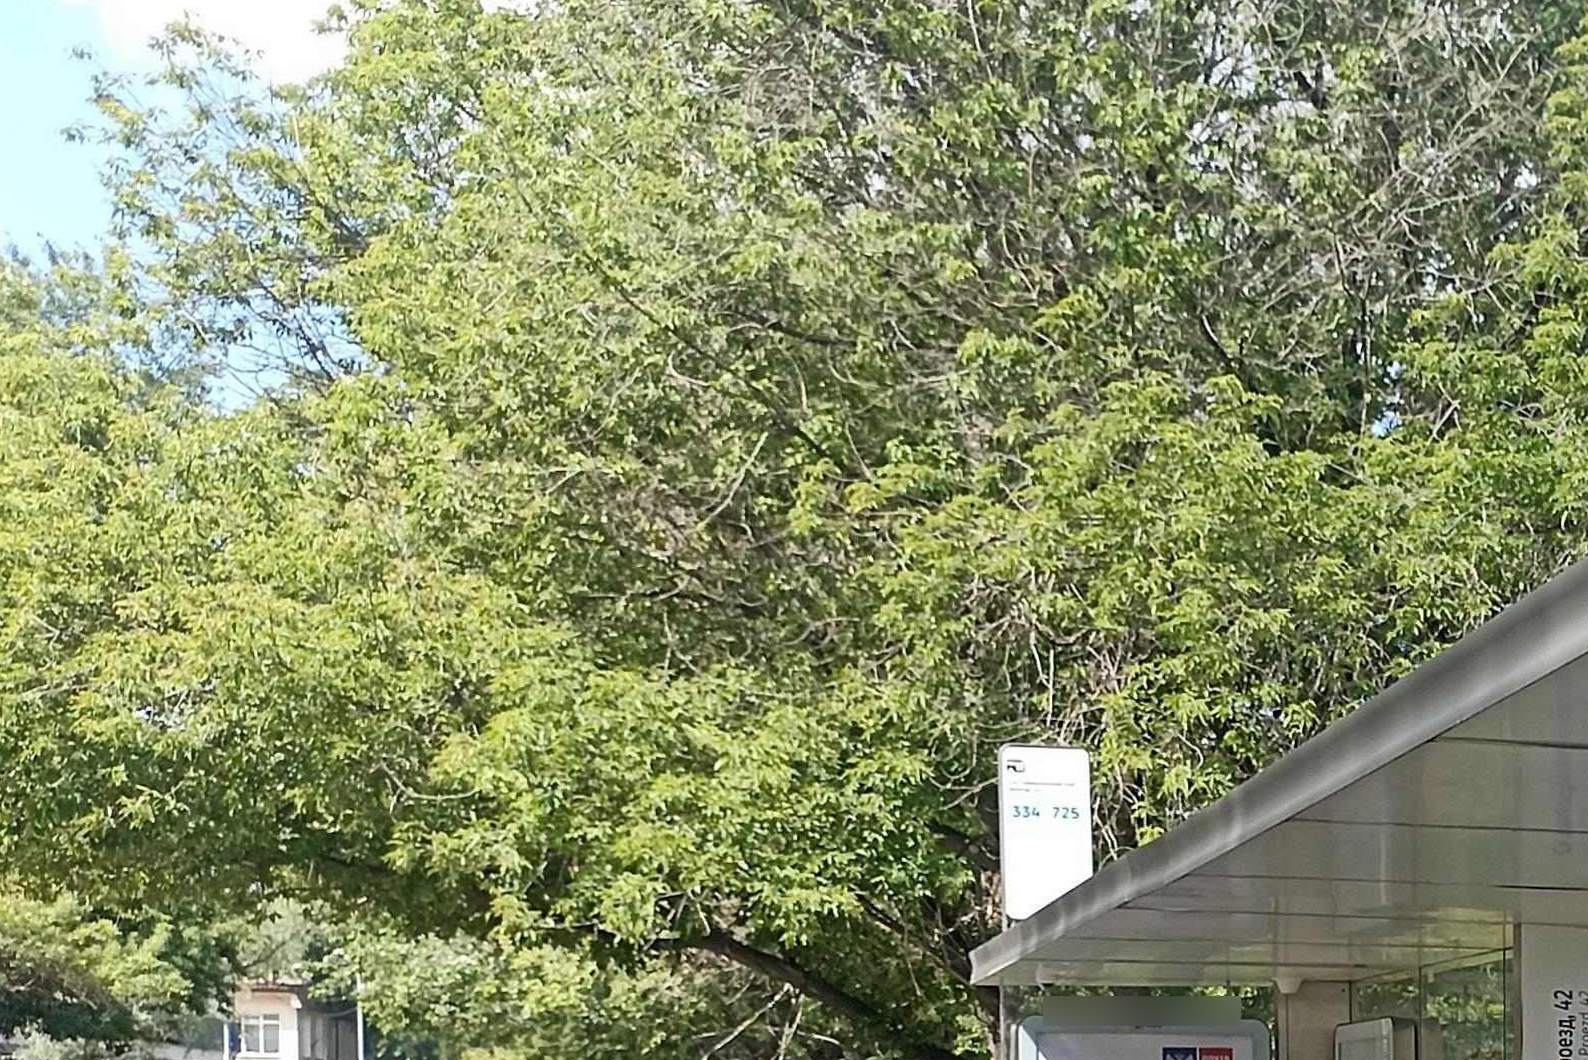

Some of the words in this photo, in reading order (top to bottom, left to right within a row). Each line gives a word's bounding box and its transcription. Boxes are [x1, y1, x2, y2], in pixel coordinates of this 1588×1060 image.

[1013, 806, 1040, 818] 334
[1053, 806, 1080, 819] 725
[1553, 990, 1574, 1012] 42
